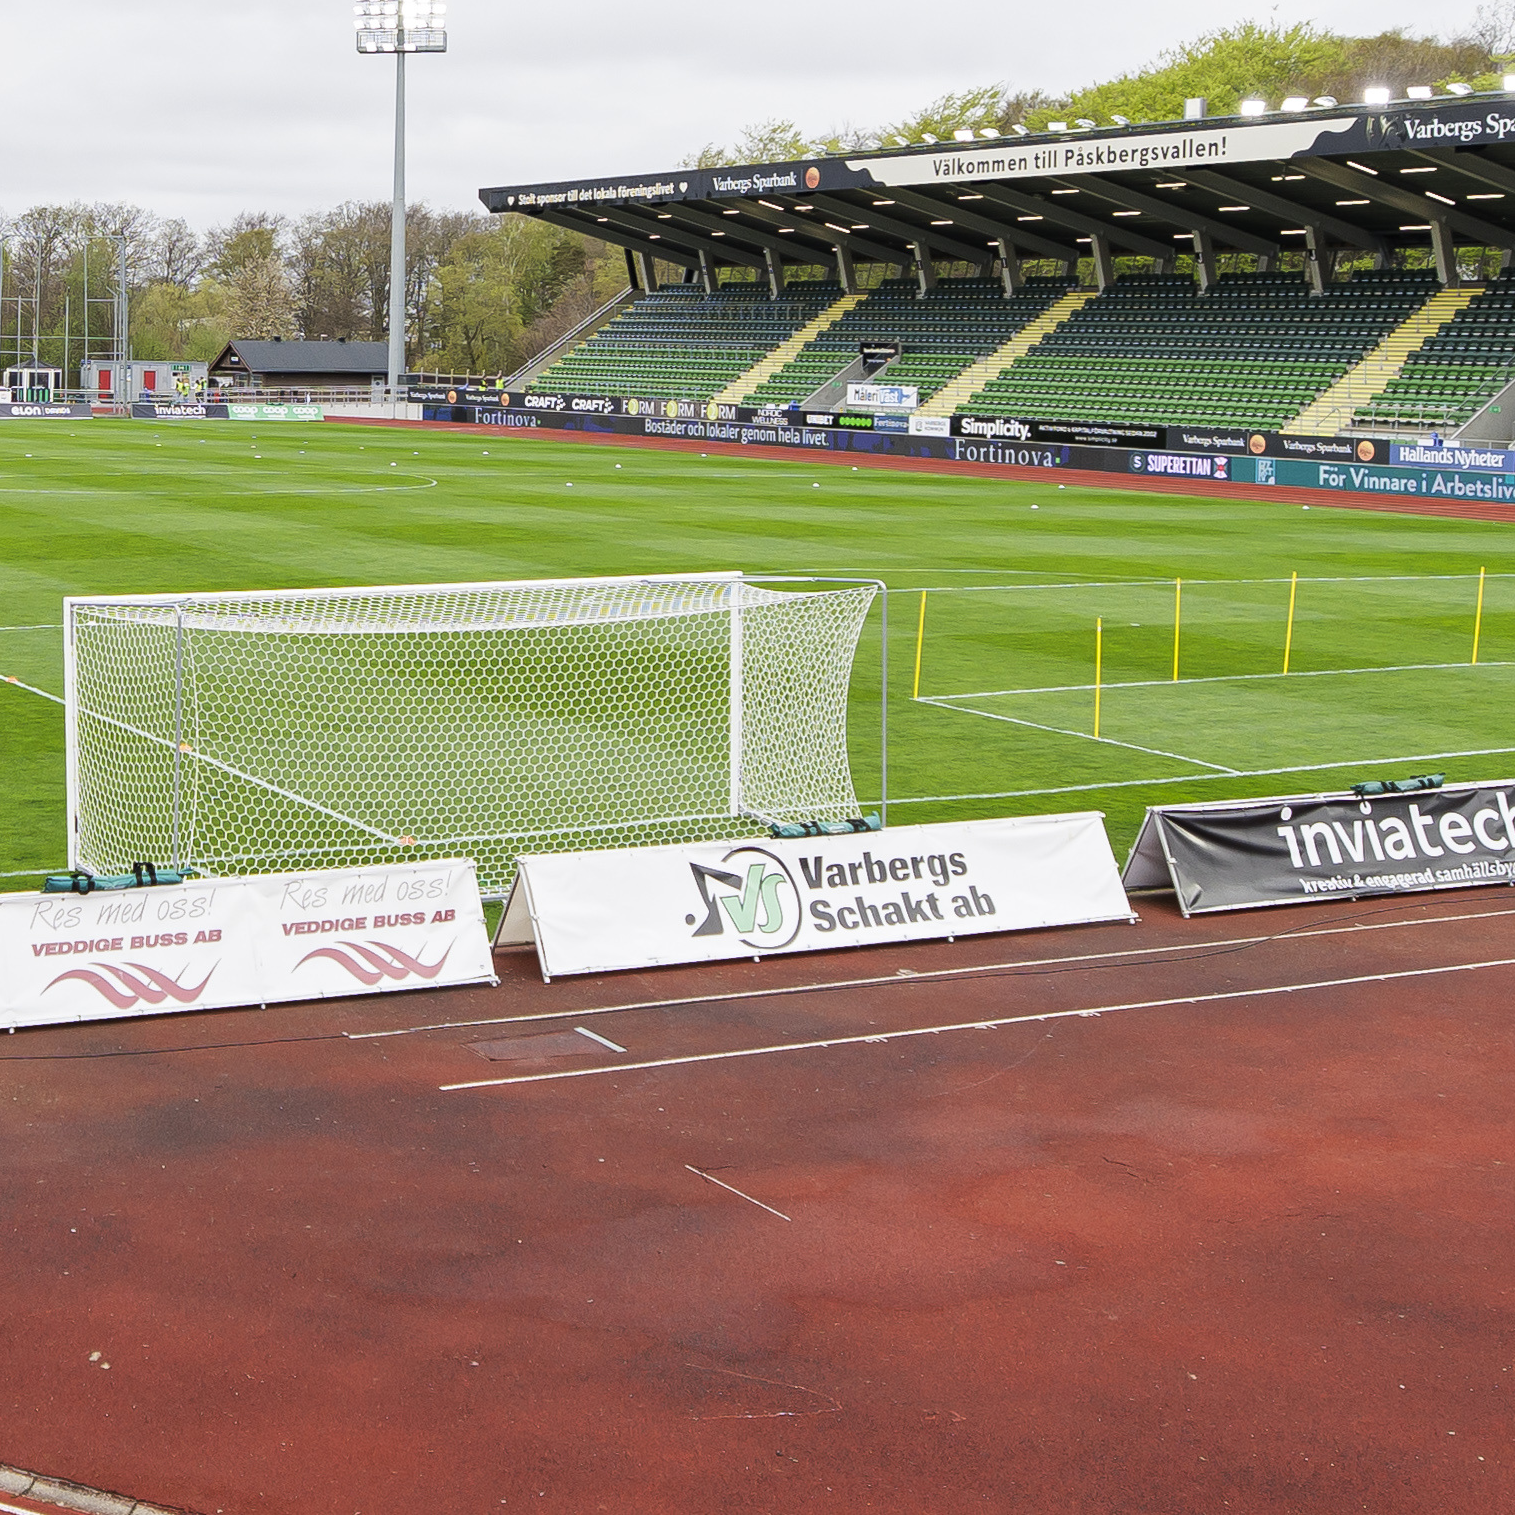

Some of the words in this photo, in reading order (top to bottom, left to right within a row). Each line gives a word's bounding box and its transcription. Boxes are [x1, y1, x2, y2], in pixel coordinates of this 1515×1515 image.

[1404, 117, 1483, 142] Varbergs
[933, 155, 1028, 177] Välkommen
[1033, 150, 1058, 170] till
[1064, 136, 1228, 167] Påskbergsvallen!
[567, 188, 578, 203] till
[579, 187, 592, 202] det
[593, 186, 616, 201] lokala
[712, 176, 752, 194] Varbergs
[753, 171, 798, 190] Sparbank
[154, 403, 206, 416] inviatech
[232, 405, 259, 415] coop
[262, 406, 289, 415] coop
[292, 407, 319, 416] coop
[524, 395, 557, 409] CRAFT
[572, 398, 605, 412] CRAFT
[757, 408, 783, 417] NORDIC
[474, 407, 537, 428] Fortinova
[751, 416, 788, 426] WELLNESS
[960, 417, 1032, 441] Simplicity.
[645, 418, 686, 436] Bostäder
[687, 422, 705, 436] och
[706, 422, 740, 440] lokaler
[741, 428, 777, 444] genom
[778, 427, 801, 444] hela
[802, 429, 829, 446] livet.
[954, 438, 1053, 467] Fortinova
[1283, 439, 1317, 454] Varbergs
[1318, 441, 1353, 455] Sparbank
[1399, 446, 1453, 465] Hallands
[1454, 449, 1505, 470] Nyheter
[1147, 454, 1211, 476] SUPERETTAN
[1319, 465, 1346, 487] För
[1350, 468, 1417, 492] Vinnare
[799, 846, 969, 890] Varbergs
[280, 880, 328, 910] Res
[342, 875, 388, 905] med
[397, 870, 452, 900] oss!
[1301, 874, 1353, 894] kreativ
[1354, 874, 1365, 888] &
[1366, 867, 1435, 891] engagerad
[30, 900, 83, 930] Res
[97, 894, 148, 925] med
[158, 888, 216, 920] oss!
[808, 889, 945, 933] Schakt
[953, 884, 997, 919] ab
[282, 917, 367, 936] VEDDIGE
[374, 912, 425, 928] BUSS
[431, 909, 455, 923] AB
[32, 938, 123, 957] VEDDIGE
[130, 932, 188, 950] BUSS
[193, 930, 222, 944] AB
